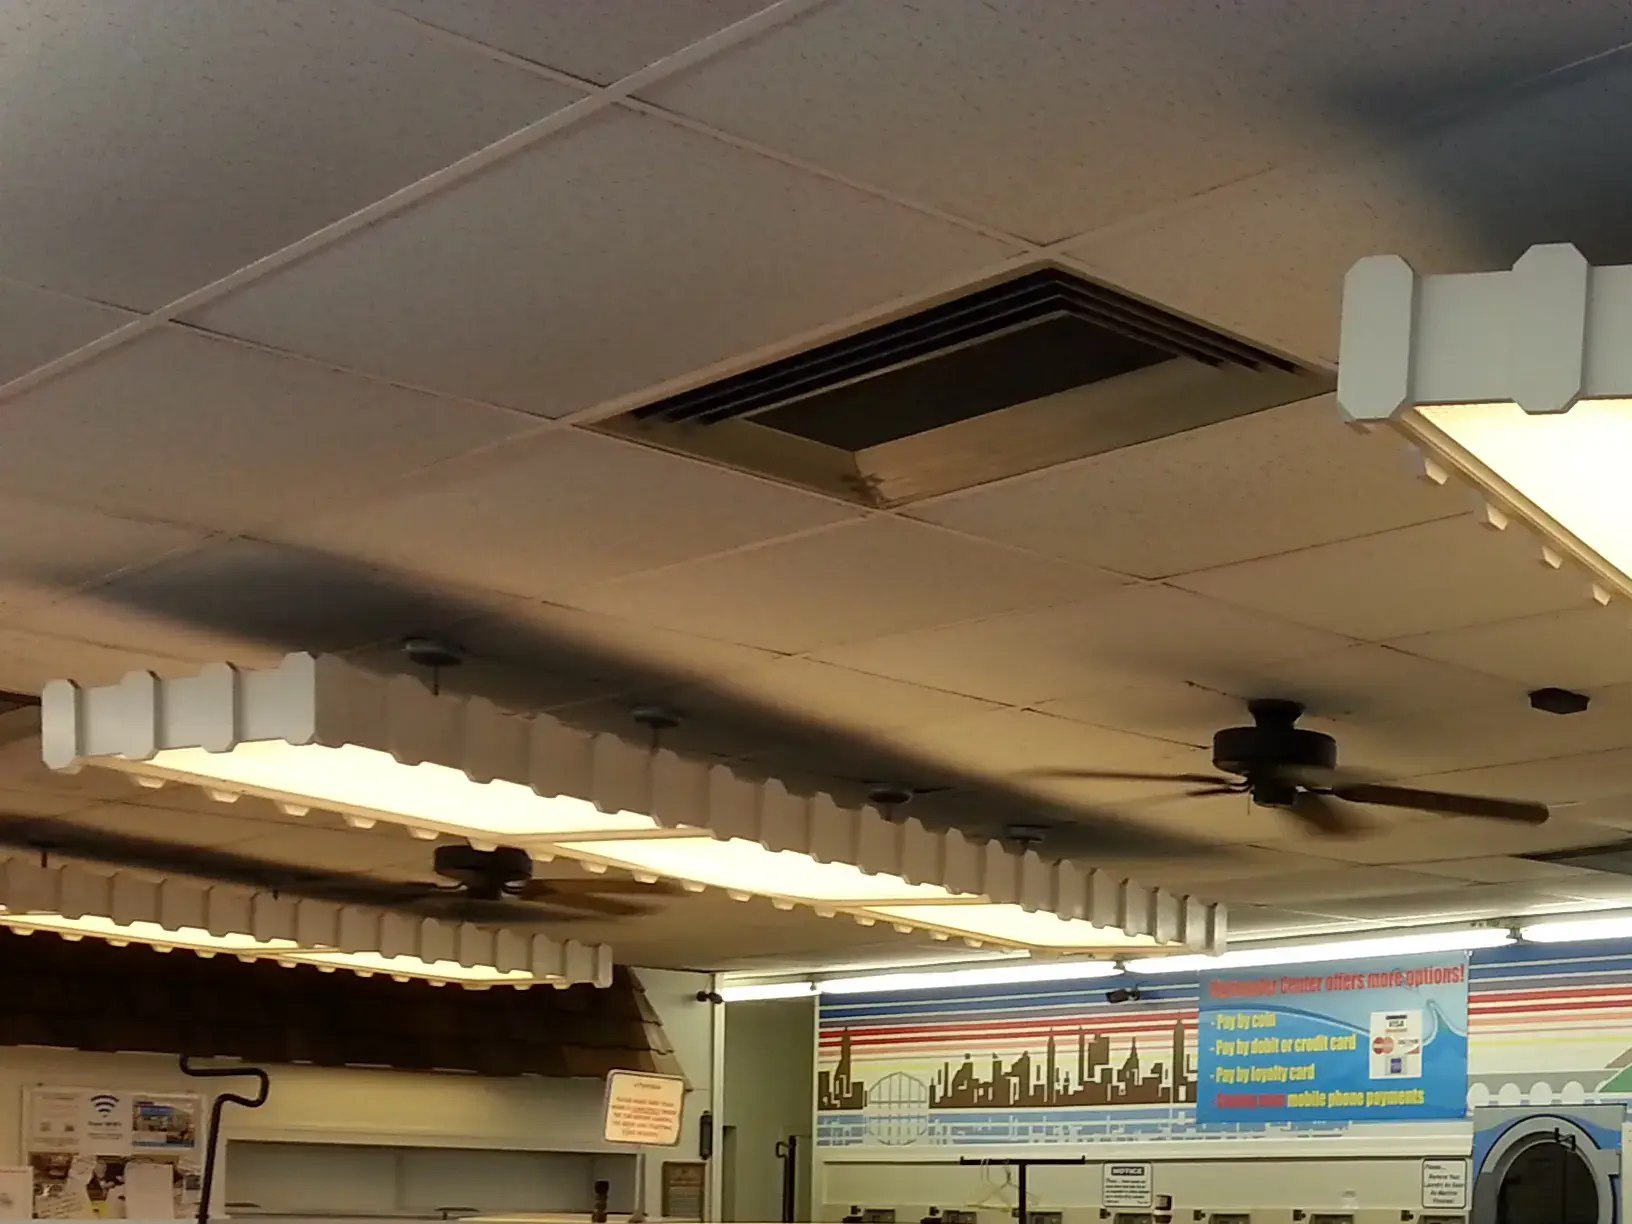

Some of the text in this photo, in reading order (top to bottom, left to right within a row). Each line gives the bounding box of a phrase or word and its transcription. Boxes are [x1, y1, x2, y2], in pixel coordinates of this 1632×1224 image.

[1326, 973, 1365, 991] offers
[1368, 971, 1402, 989] more
[1406, 964, 1465, 987] options!
[1216, 1013, 1236, 1031] Pay
[1237, 1012, 1250, 1030] by
[1216, 1039, 1235, 1057] Pay
[1236, 1038, 1250, 1056] by
[1294, 1034, 1328, 1053] credit
[1330, 1034, 1357, 1051] card
[1216, 1063, 1315, 1084] Pay by loyalty card
[1287, 1090, 1326, 1108] mobile
[1328, 1089, 1364, 1108] phone
[1366, 1088, 1425, 1108] payments
